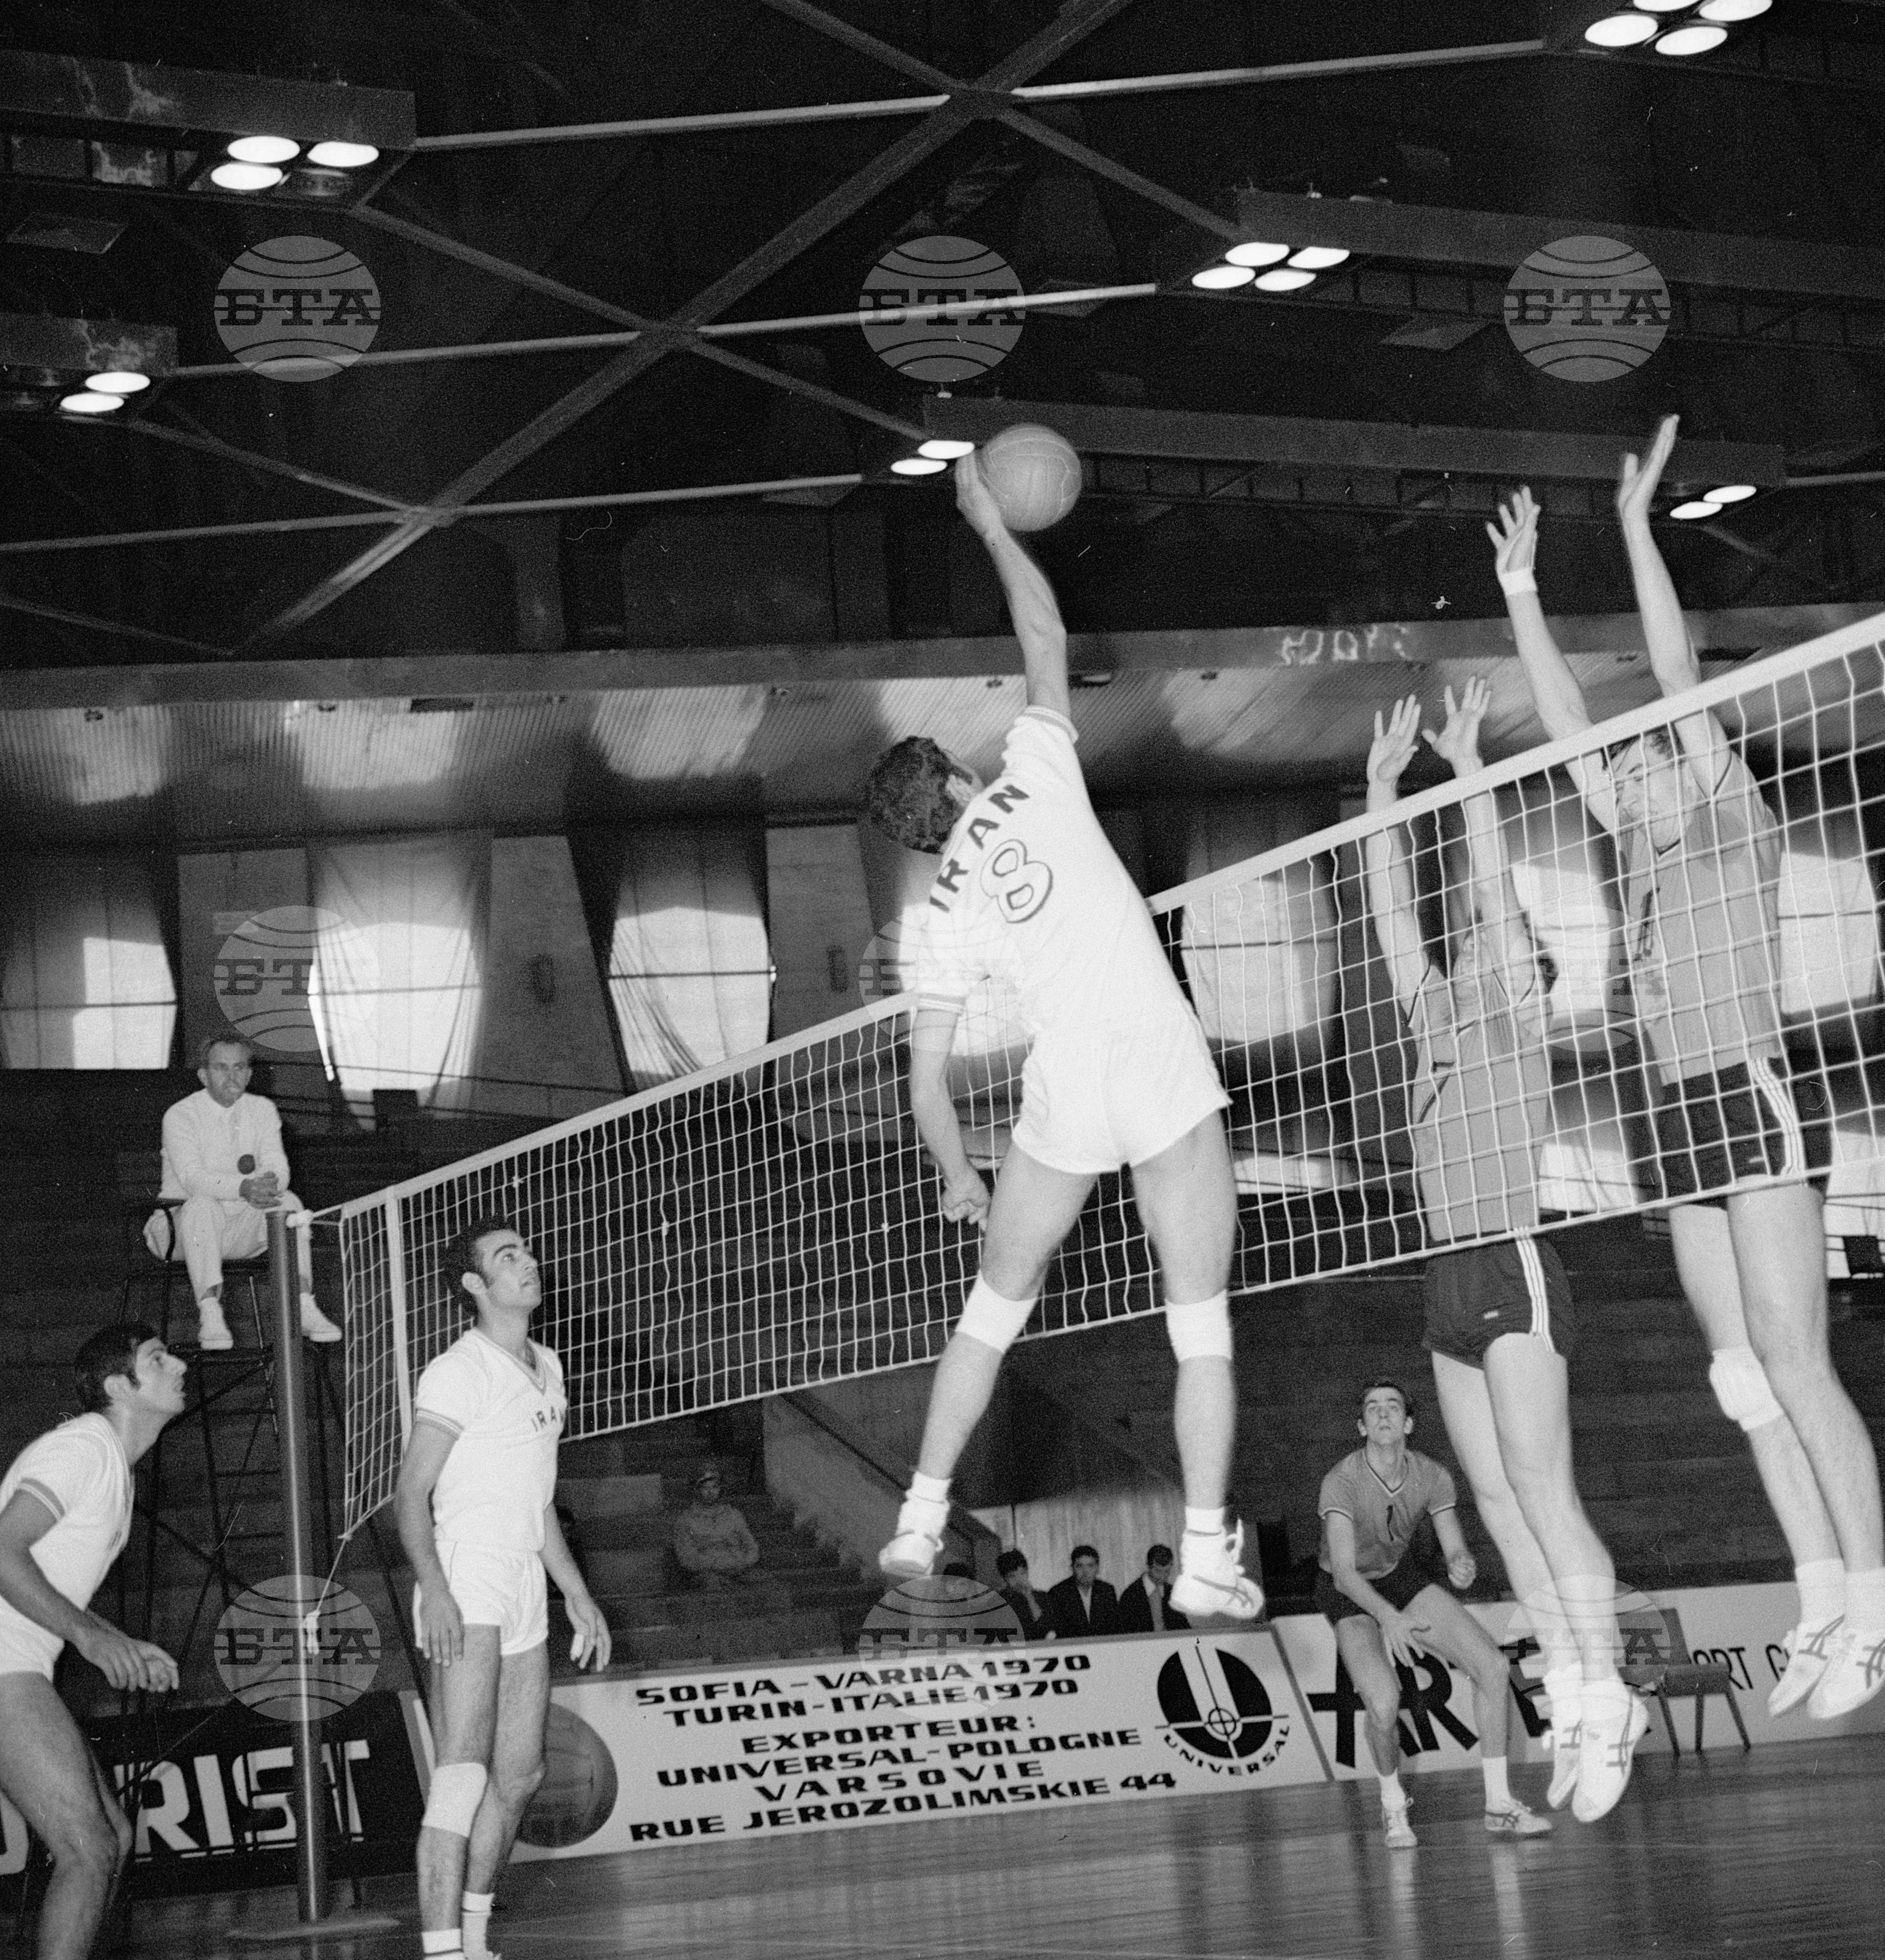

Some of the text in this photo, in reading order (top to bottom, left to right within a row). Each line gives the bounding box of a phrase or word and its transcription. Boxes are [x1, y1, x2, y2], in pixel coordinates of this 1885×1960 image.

[929, 784, 1030, 914] IRAN
[979, 838, 1053, 924] 8
[981, 1654, 1091, 1677] 1970
[973, 1679, 1078, 1701] 1970
[741, 1715, 1035, 1754] EXPORTEUR:
[1163, 1726, 1290, 1777] UNIVERSAL
[754, 1761, 1045, 1802] VARSOVIE
[629, 1772, 1176, 1842] RUE JEROZOLIMSKIE 44
